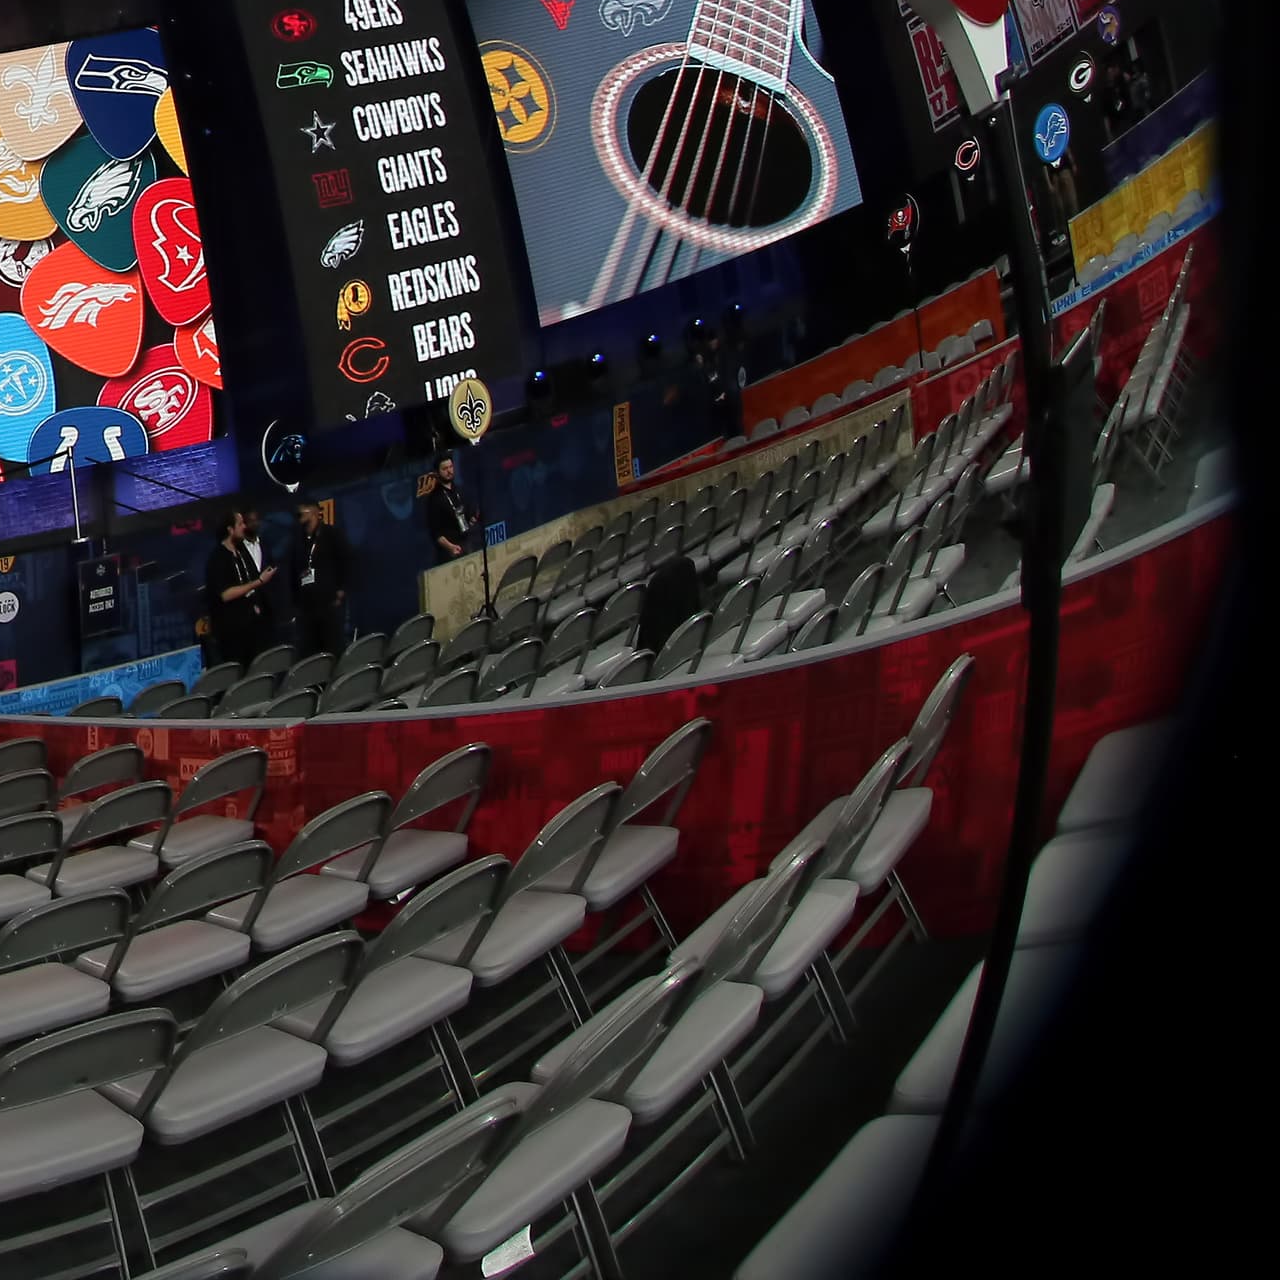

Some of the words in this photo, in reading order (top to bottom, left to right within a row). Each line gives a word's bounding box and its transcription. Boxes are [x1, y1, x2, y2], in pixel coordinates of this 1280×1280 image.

[340, 37, 447, 88] SEAHAWKS
[352, 92, 448, 143] COWBOYS
[377, 146, 448, 195] GIANTS
[387, 200, 460, 251] EAGLES
[387, 254, 481, 313] REDSKINS
[412, 311, 476, 363] BEARS
[0, 557, 11, 572] 19
